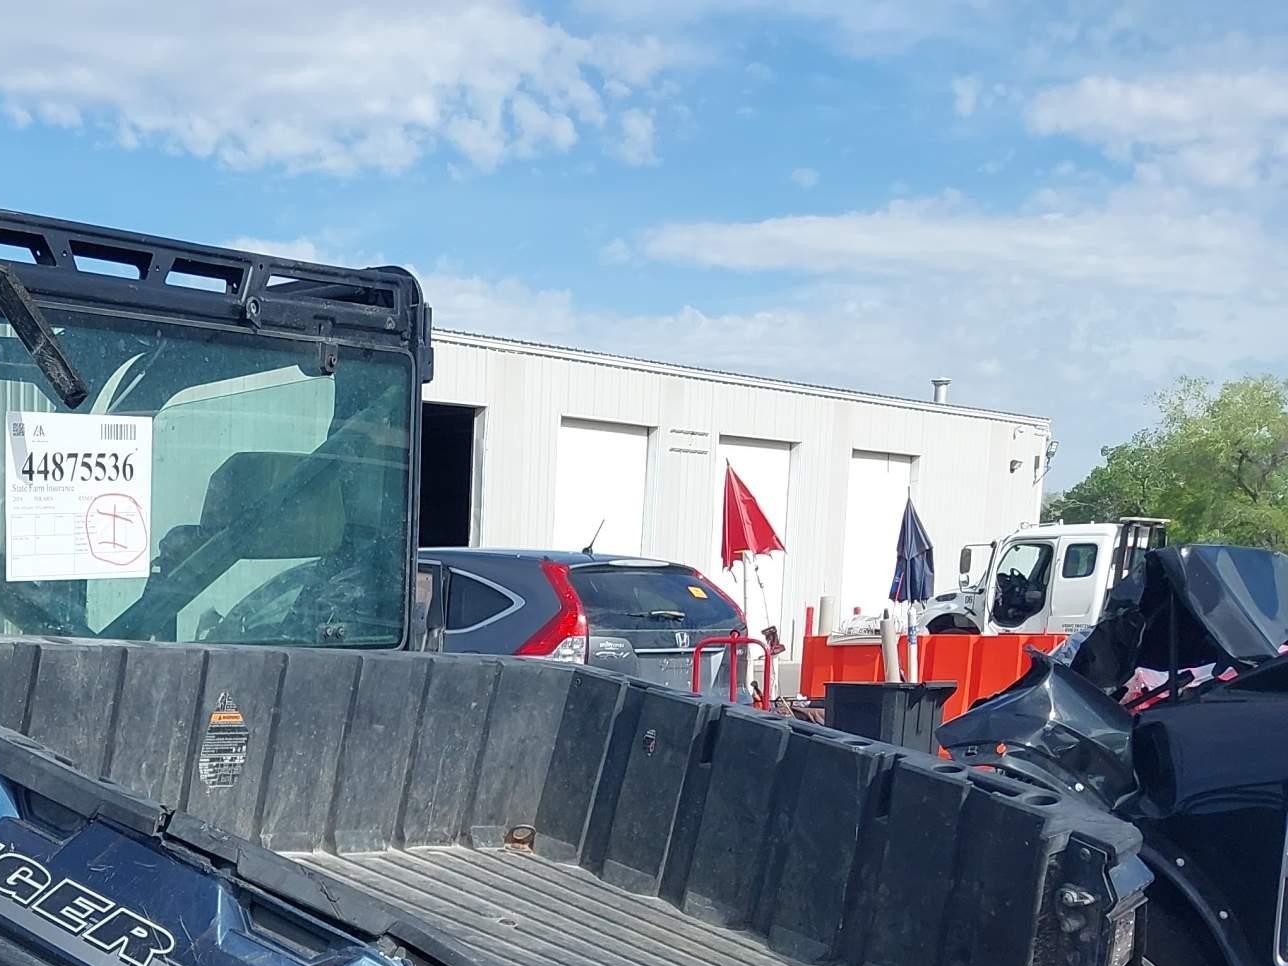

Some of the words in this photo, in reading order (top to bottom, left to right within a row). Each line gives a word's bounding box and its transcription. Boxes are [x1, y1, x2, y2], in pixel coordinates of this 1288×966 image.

[21, 451, 136, 482] 44875536
[11, 484, 28, 493] State
[29, 484, 45, 493] Farm
